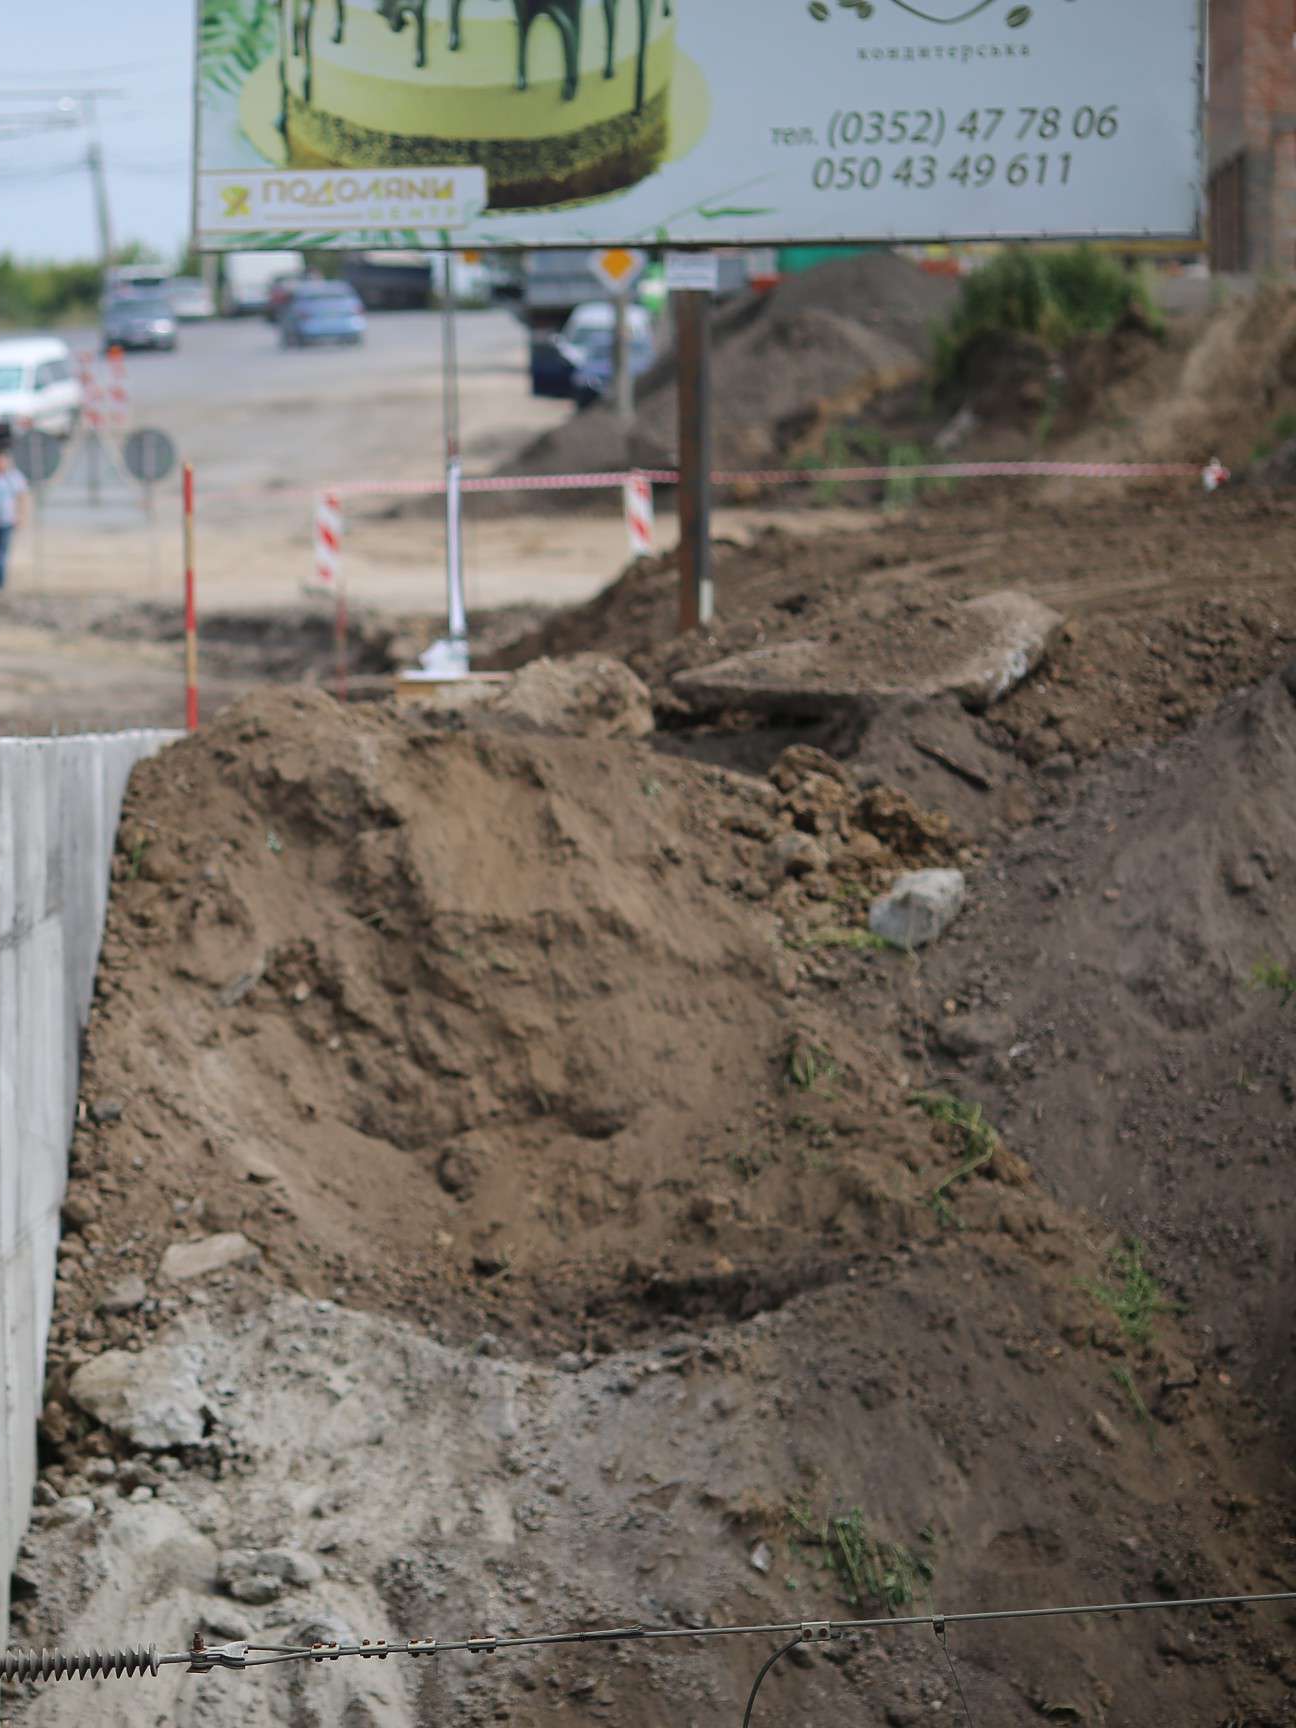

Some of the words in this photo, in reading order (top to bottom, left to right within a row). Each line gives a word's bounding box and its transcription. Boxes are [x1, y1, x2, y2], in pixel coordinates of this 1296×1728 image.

[856, 44, 1031, 63] кондитерська
[769, 126, 819, 147] тел.
[827, 107, 946, 149] (0352)
[957, 107, 1005, 142] 47
[1016, 105, 1061, 141] 78
[1072, 104, 1119, 140] 06
[811, 155, 882, 191] 050
[892, 154, 938, 189] 43
[949, 152, 997, 188] 49
[1007, 151, 1072, 187] 611
